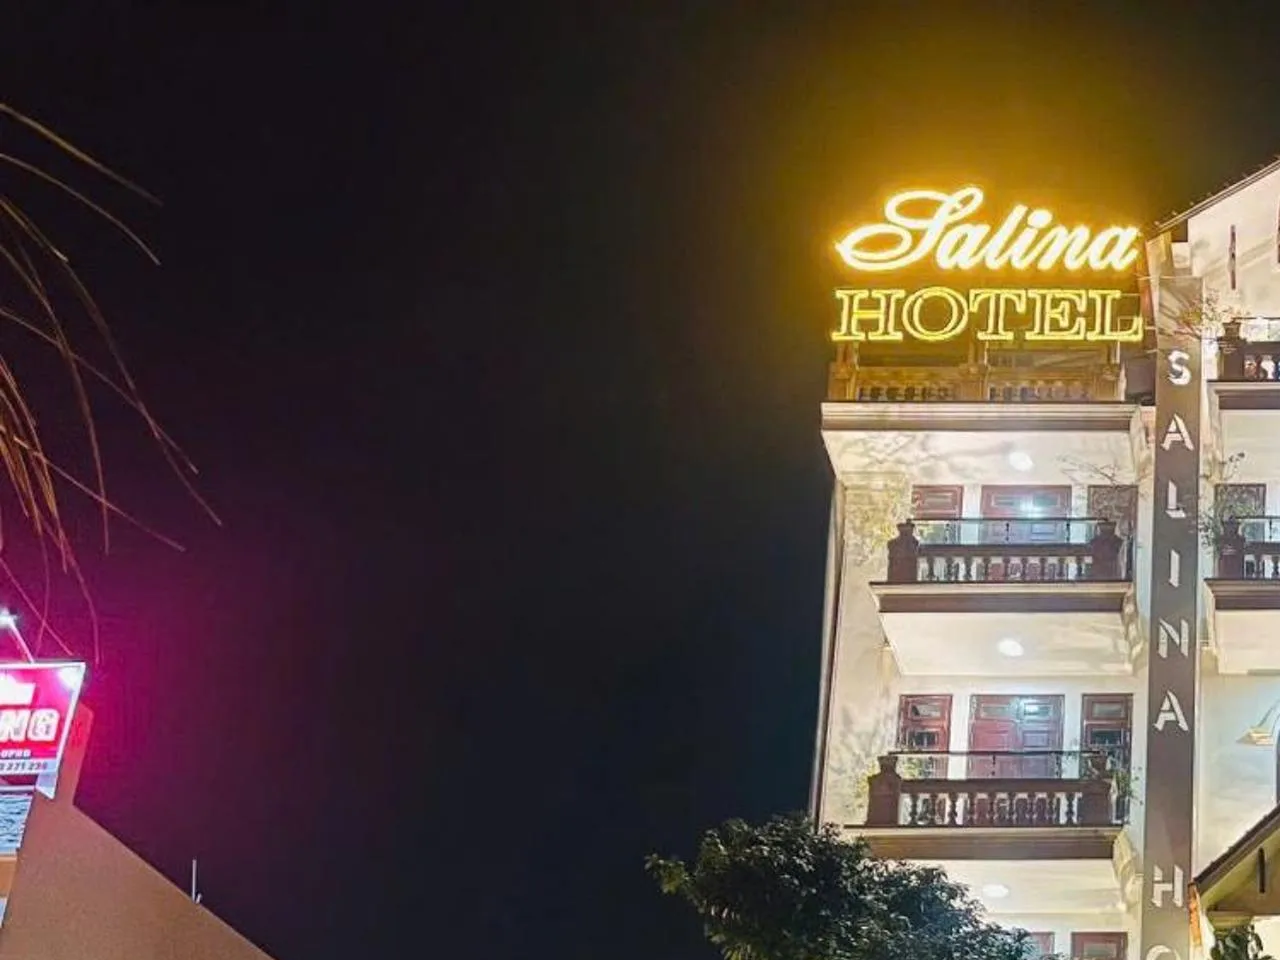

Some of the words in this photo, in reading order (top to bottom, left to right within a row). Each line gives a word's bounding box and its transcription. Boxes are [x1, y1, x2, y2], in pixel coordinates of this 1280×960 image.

[837, 187, 1140, 271] Salina
[832, 287, 1143, 341] HOTEL
[1153, 350, 1194, 732] SALINA
